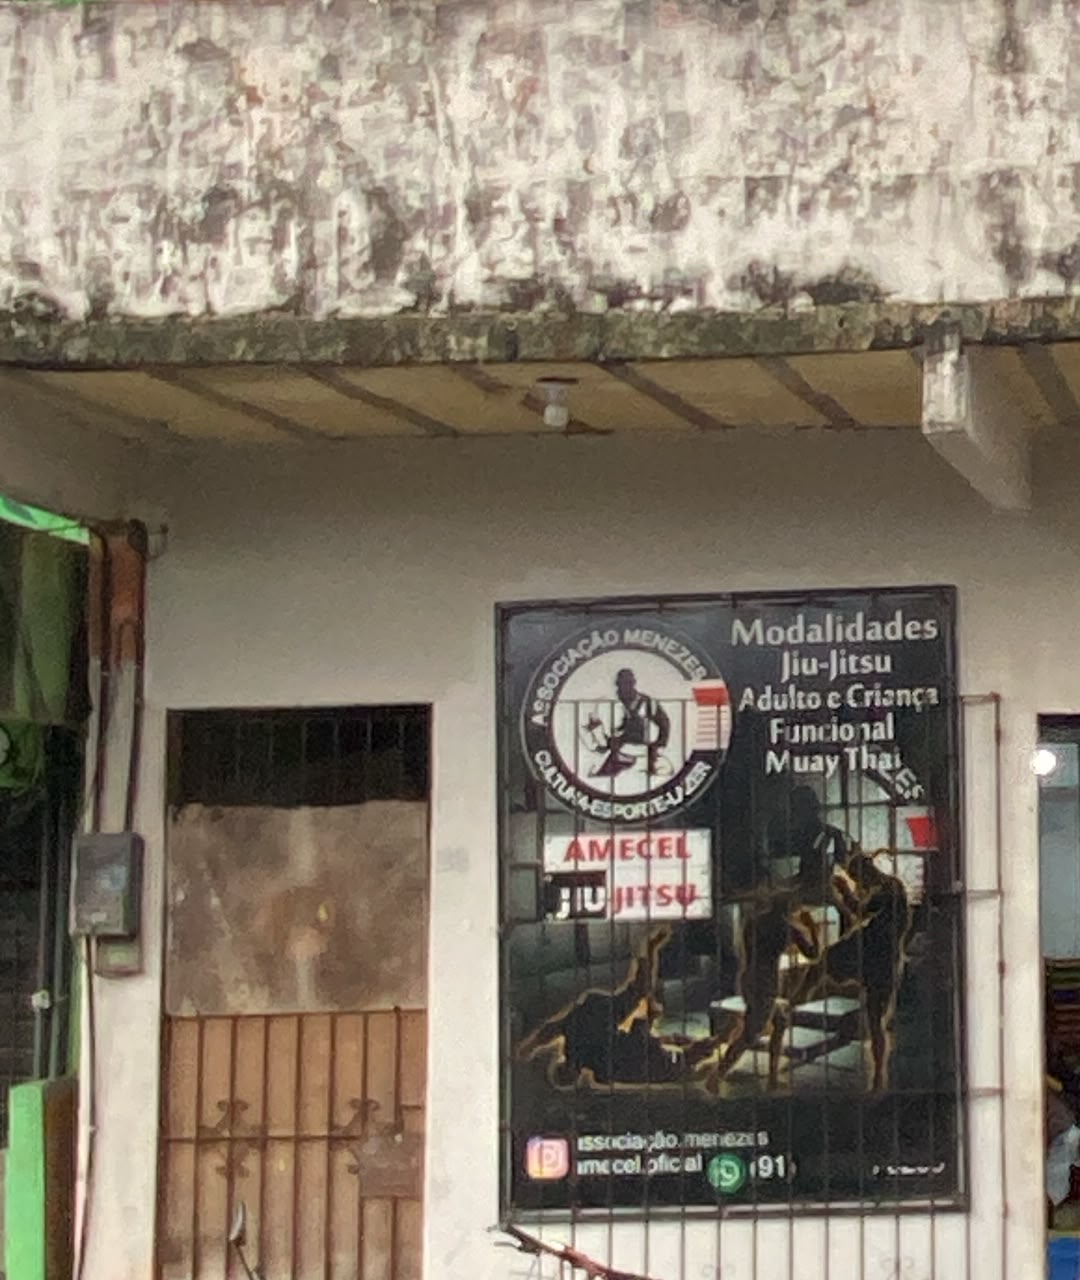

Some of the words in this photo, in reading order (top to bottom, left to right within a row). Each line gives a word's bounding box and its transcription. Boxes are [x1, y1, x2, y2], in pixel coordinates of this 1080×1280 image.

[731, 609, 938, 647] Modalidades
[530, 629, 619, 726] ASSOCIAÇÃO
[623, 628, 708, 681] MENEZES
[781, 648, 892, 683] Jiu-Jitsu
[738, 683, 822, 712] Adulto
[845, 682, 939, 713] Criança
[769, 712, 895, 745] Funcional
[765, 749, 839, 779] Muay
[843, 744, 902, 772] Thai
[563, 835, 692, 862] AMECEL
[556, 886, 606, 919] JIU
[613, 884, 697, 914] JITSU
